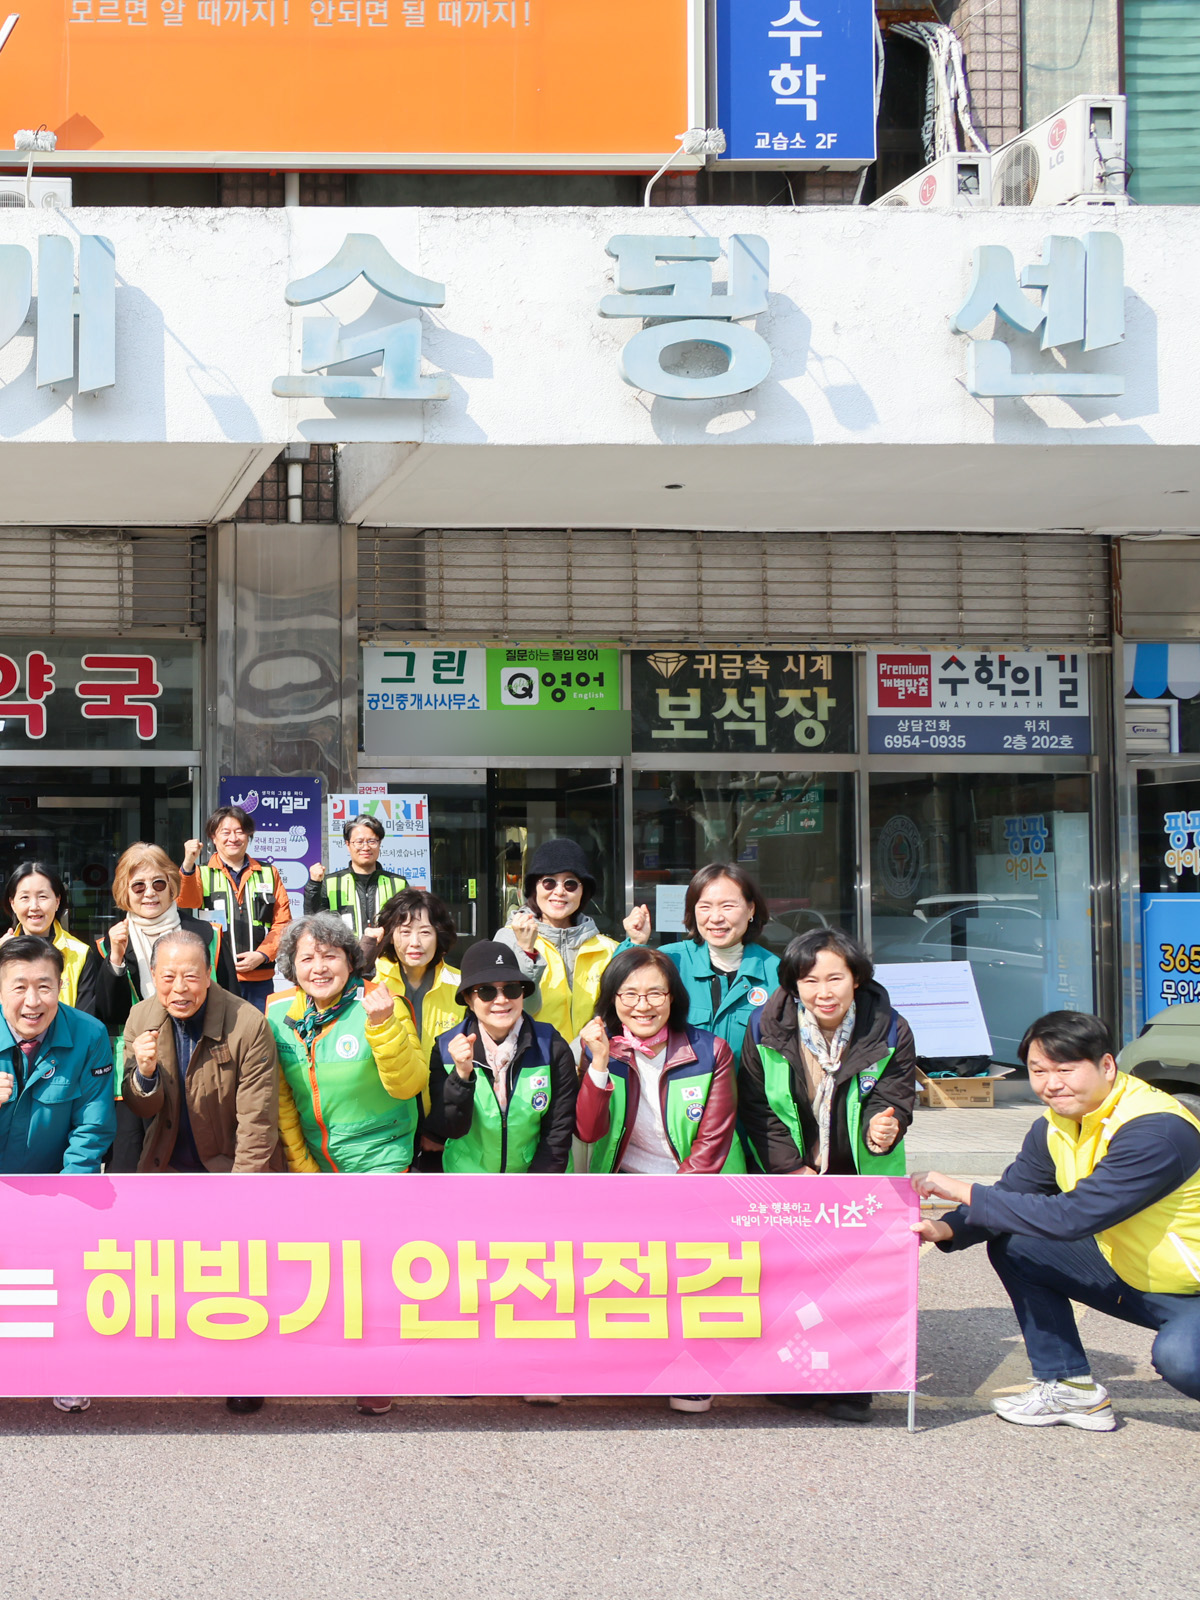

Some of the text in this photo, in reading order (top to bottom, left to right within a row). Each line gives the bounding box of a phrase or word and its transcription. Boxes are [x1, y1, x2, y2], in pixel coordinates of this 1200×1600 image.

[69, 0, 530, 29] 모르면 알 때까지! 안되면 될 때까지!
[755, 132, 838, 151] 교습소 2F
[1048, 150, 1065, 170] LG
[505, 649, 599, 661] 질문하는 몰입 영어
[381, 650, 467, 684] 그린
[693, 654, 832, 680] 귀금속 시계
[879, 663, 929, 675] Premium
[573, 692, 605, 700] English
[881, 676, 929, 699] 개별맞춤
[367, 693, 480, 710] 공인중개사사무소
[651, 686, 837, 747] 보석장
[897, 719, 1051, 732] 상담전화 위치
[884, 735, 1075, 750] 6954-0935 2층 202호
[358, 786, 386, 794] 금연구역
[386, 820, 425, 832] 미술학원
[397, 867, 427, 880] 미술교육
[1005, 856, 1049, 882] 아이스
[748, 1202, 812, 1214] 오늘 행복하고
[814, 1200, 867, 1228] 서초
[731, 1215, 812, 1227] 내일이 기다려지는
[83, 1239, 364, 1341] 해빙기
[391, 1240, 762, 1339] 안전점검
